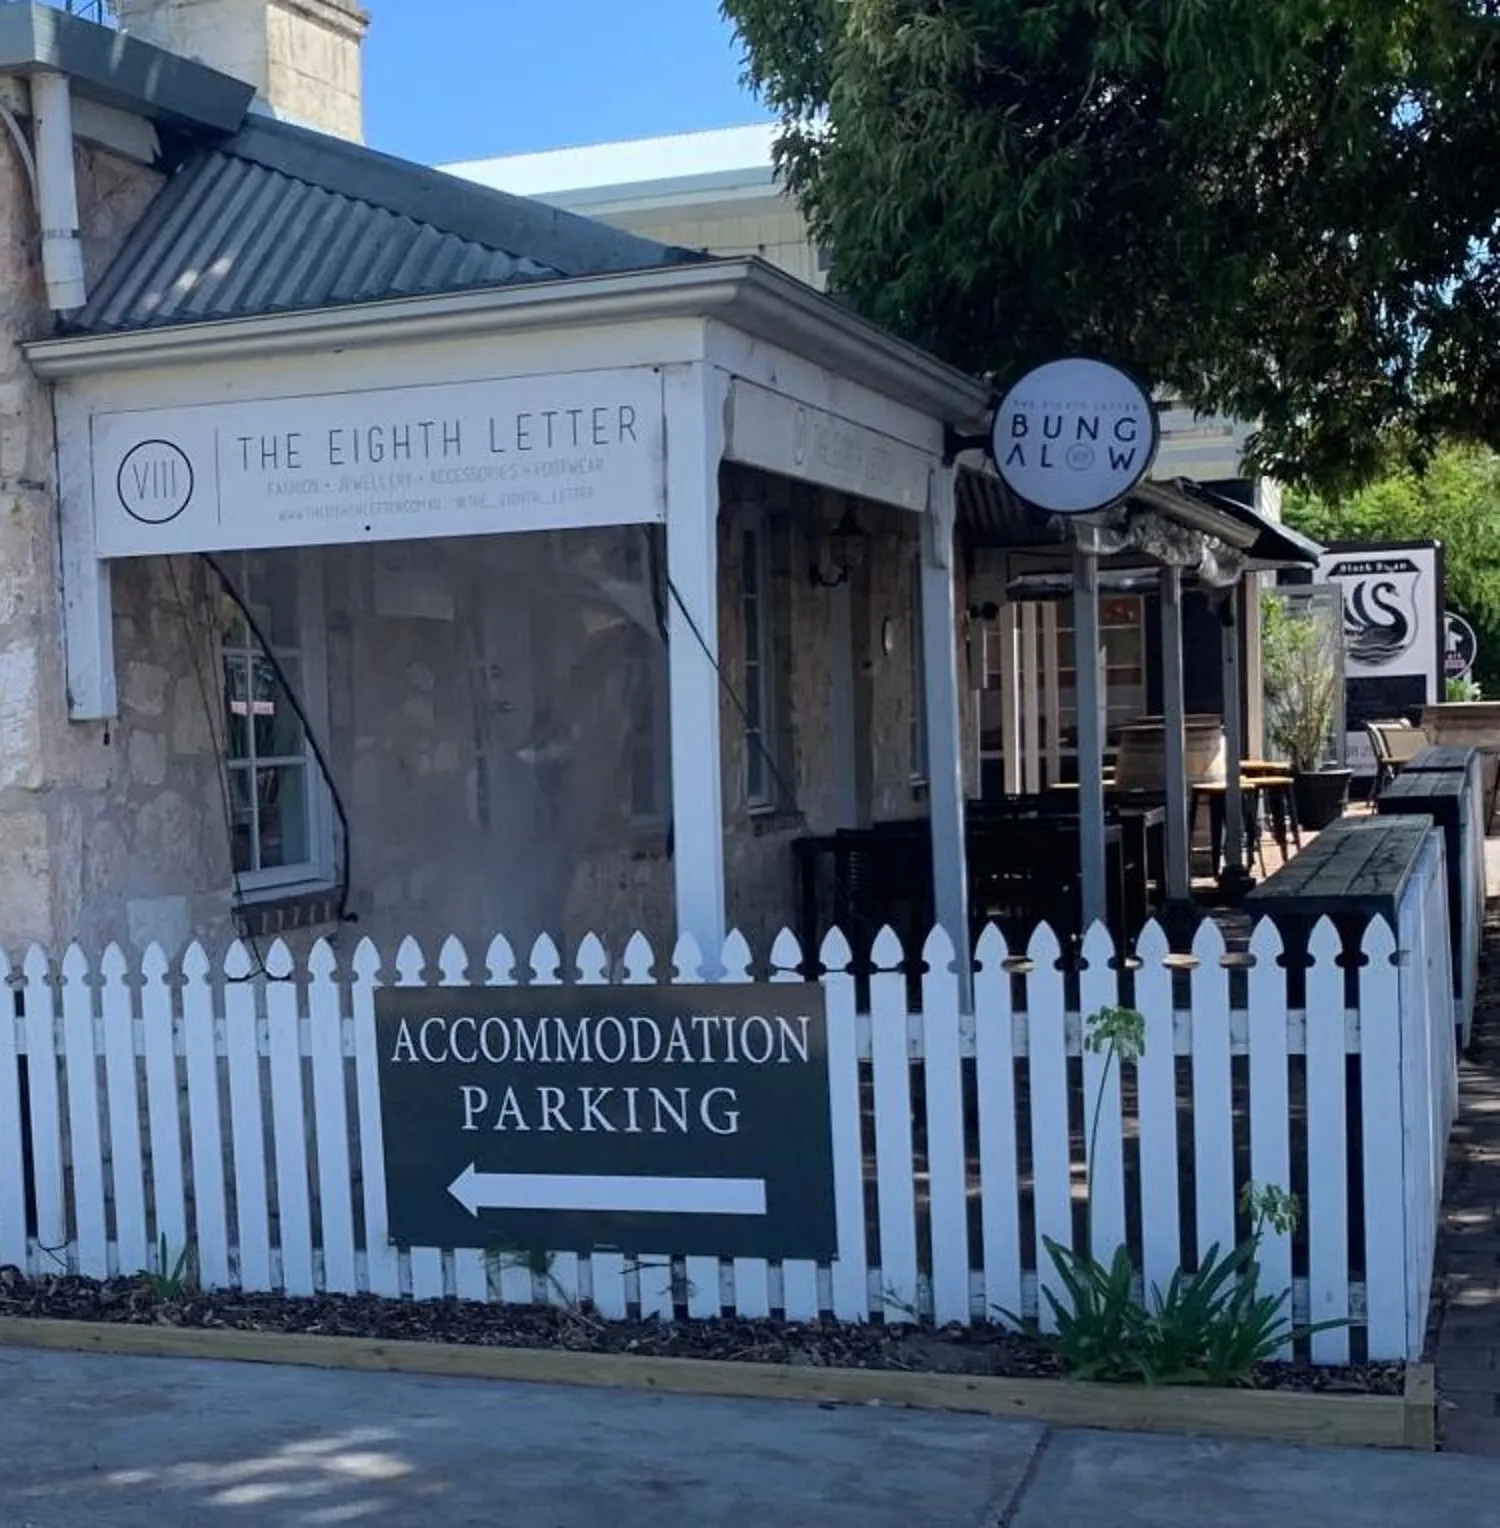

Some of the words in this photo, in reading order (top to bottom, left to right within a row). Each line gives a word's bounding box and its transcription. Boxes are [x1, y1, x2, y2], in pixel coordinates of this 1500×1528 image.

[236, 432, 302, 472] THE
[328, 419, 461, 466] EIGHTH
[489, 405, 638, 454] LETTER
[1011, 413, 1137, 443] BUNG
[132, 459, 177, 501] VIII
[390, 1015, 811, 1064] ACCOMMODATION
[459, 1085, 742, 1135] PARKING
